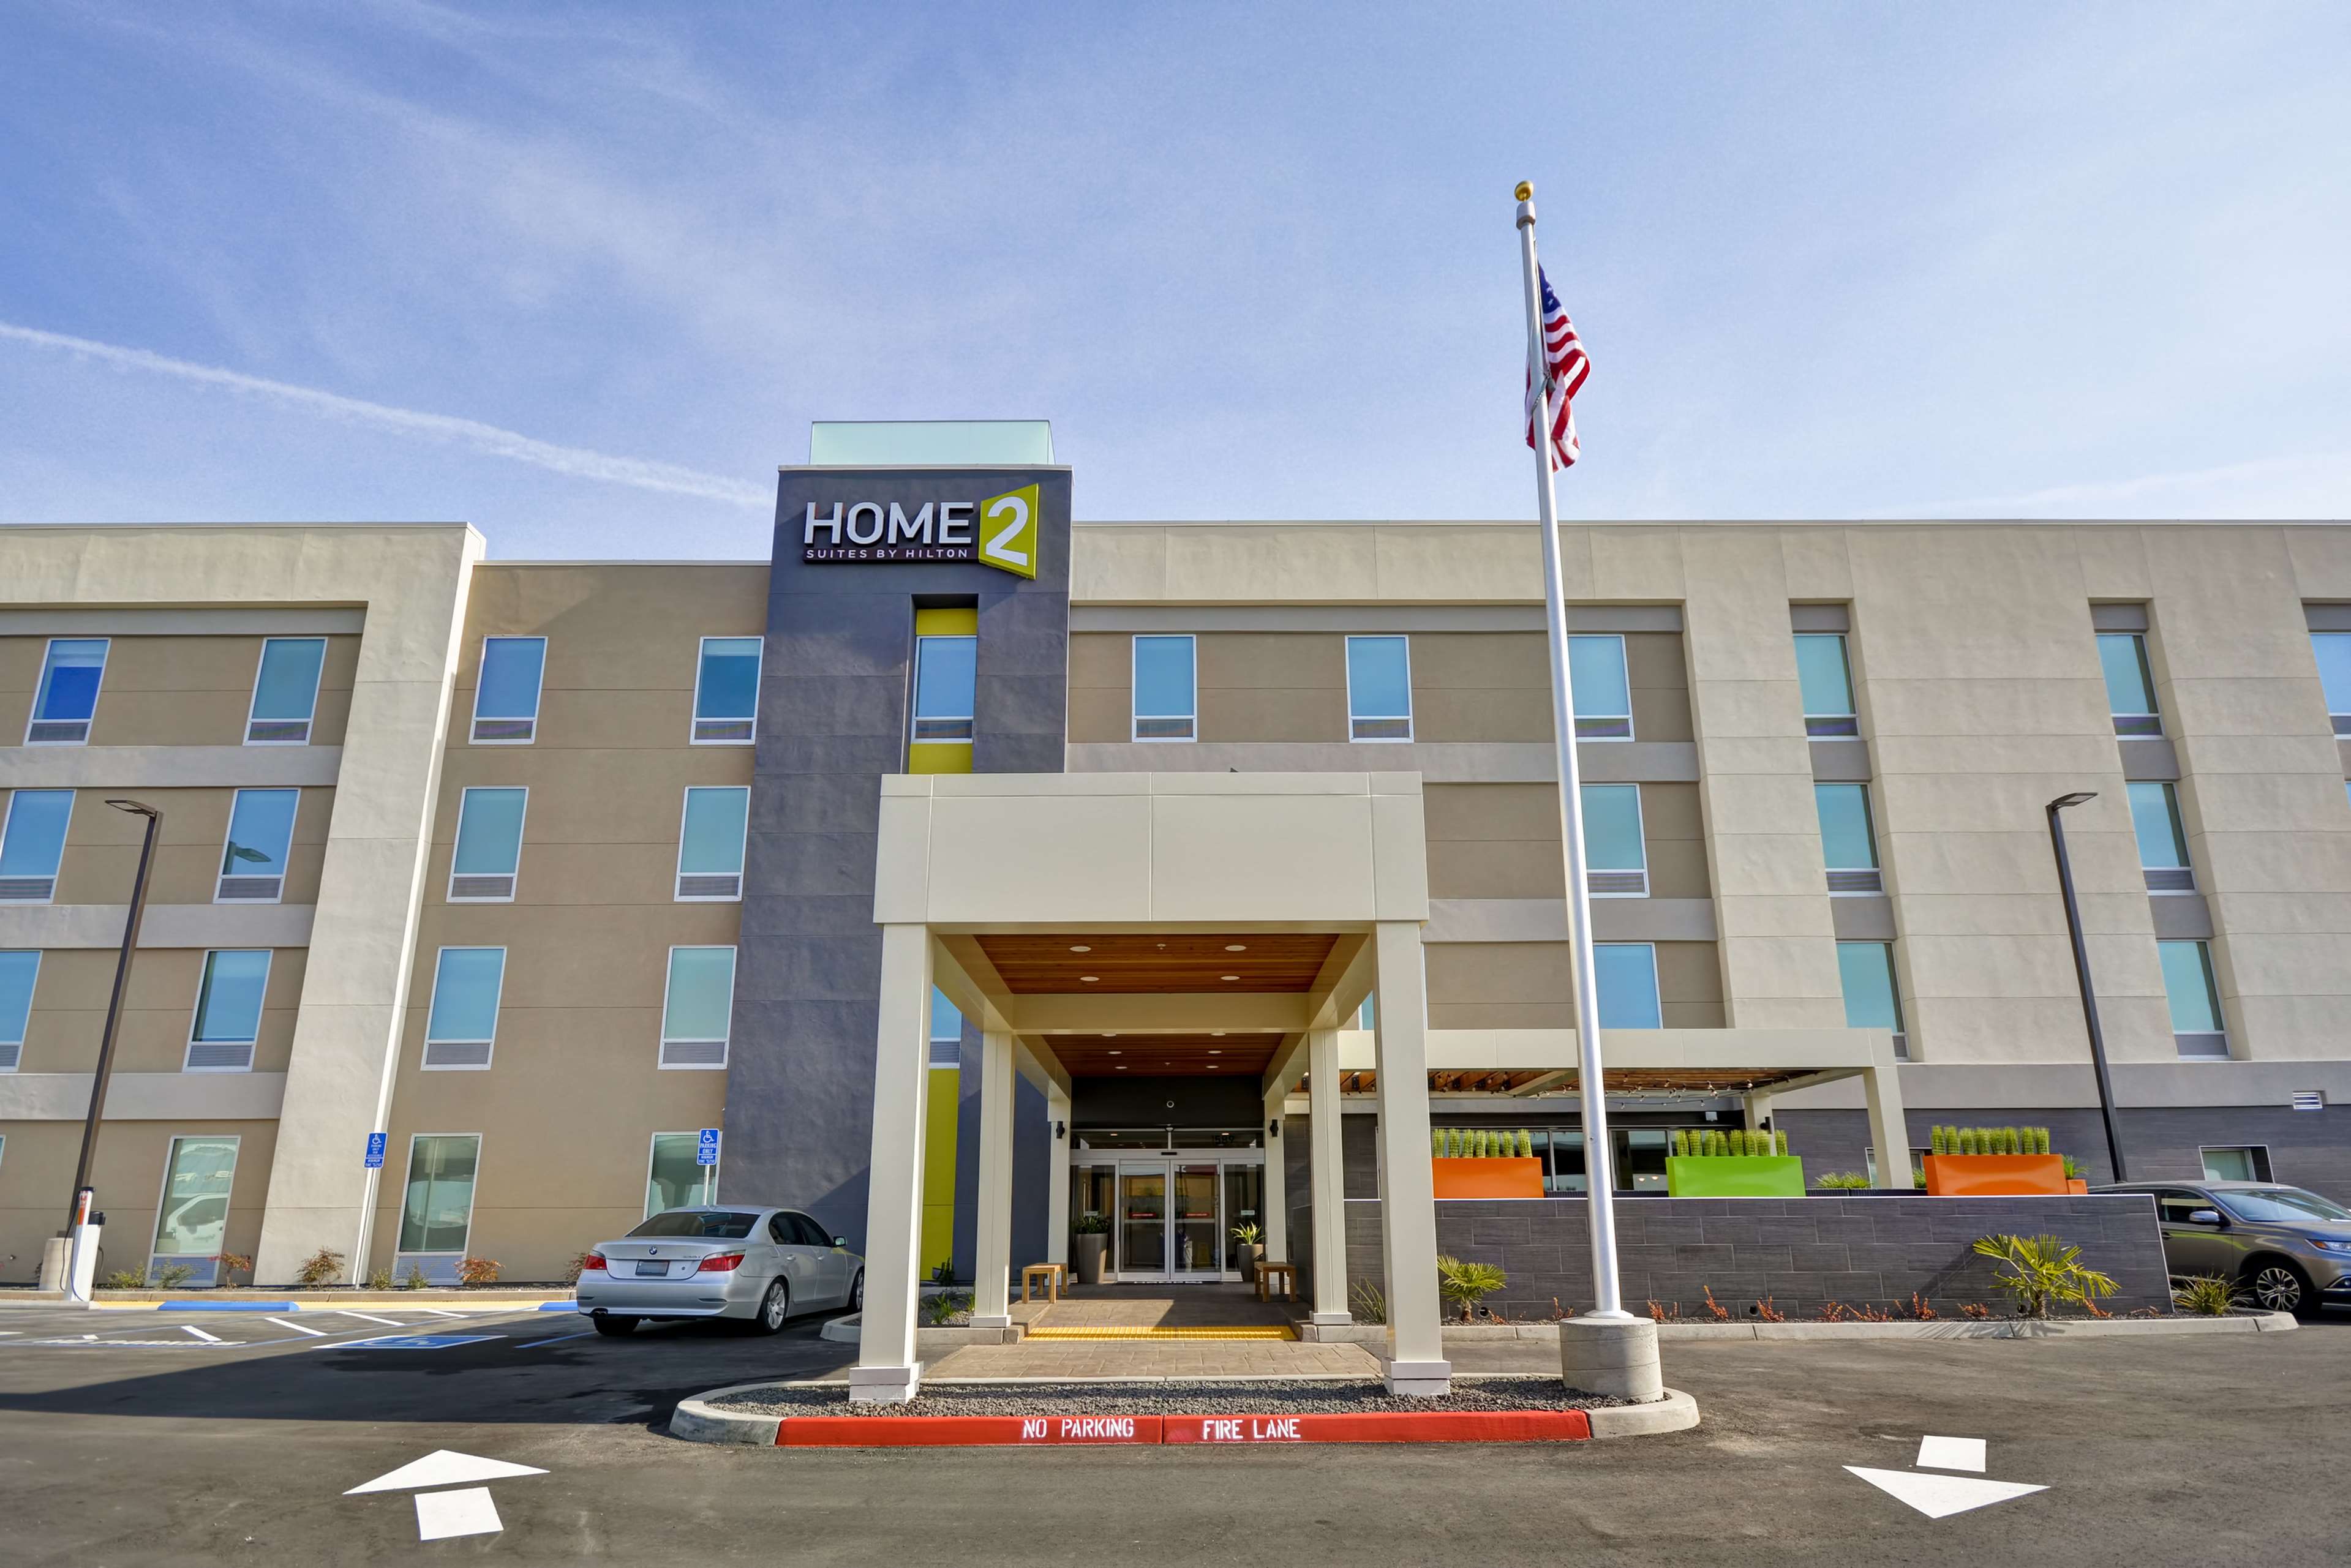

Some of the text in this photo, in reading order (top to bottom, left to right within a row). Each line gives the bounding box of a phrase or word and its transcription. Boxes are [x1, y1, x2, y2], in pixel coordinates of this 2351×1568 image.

[804, 496, 1029, 567] HOME 2
[806, 549, 968, 558] SUITES BY HILTON
[1023, 1418, 1134, 1438] NO PARKING
[1203, 1419, 1301, 1439] FIRE LANE
